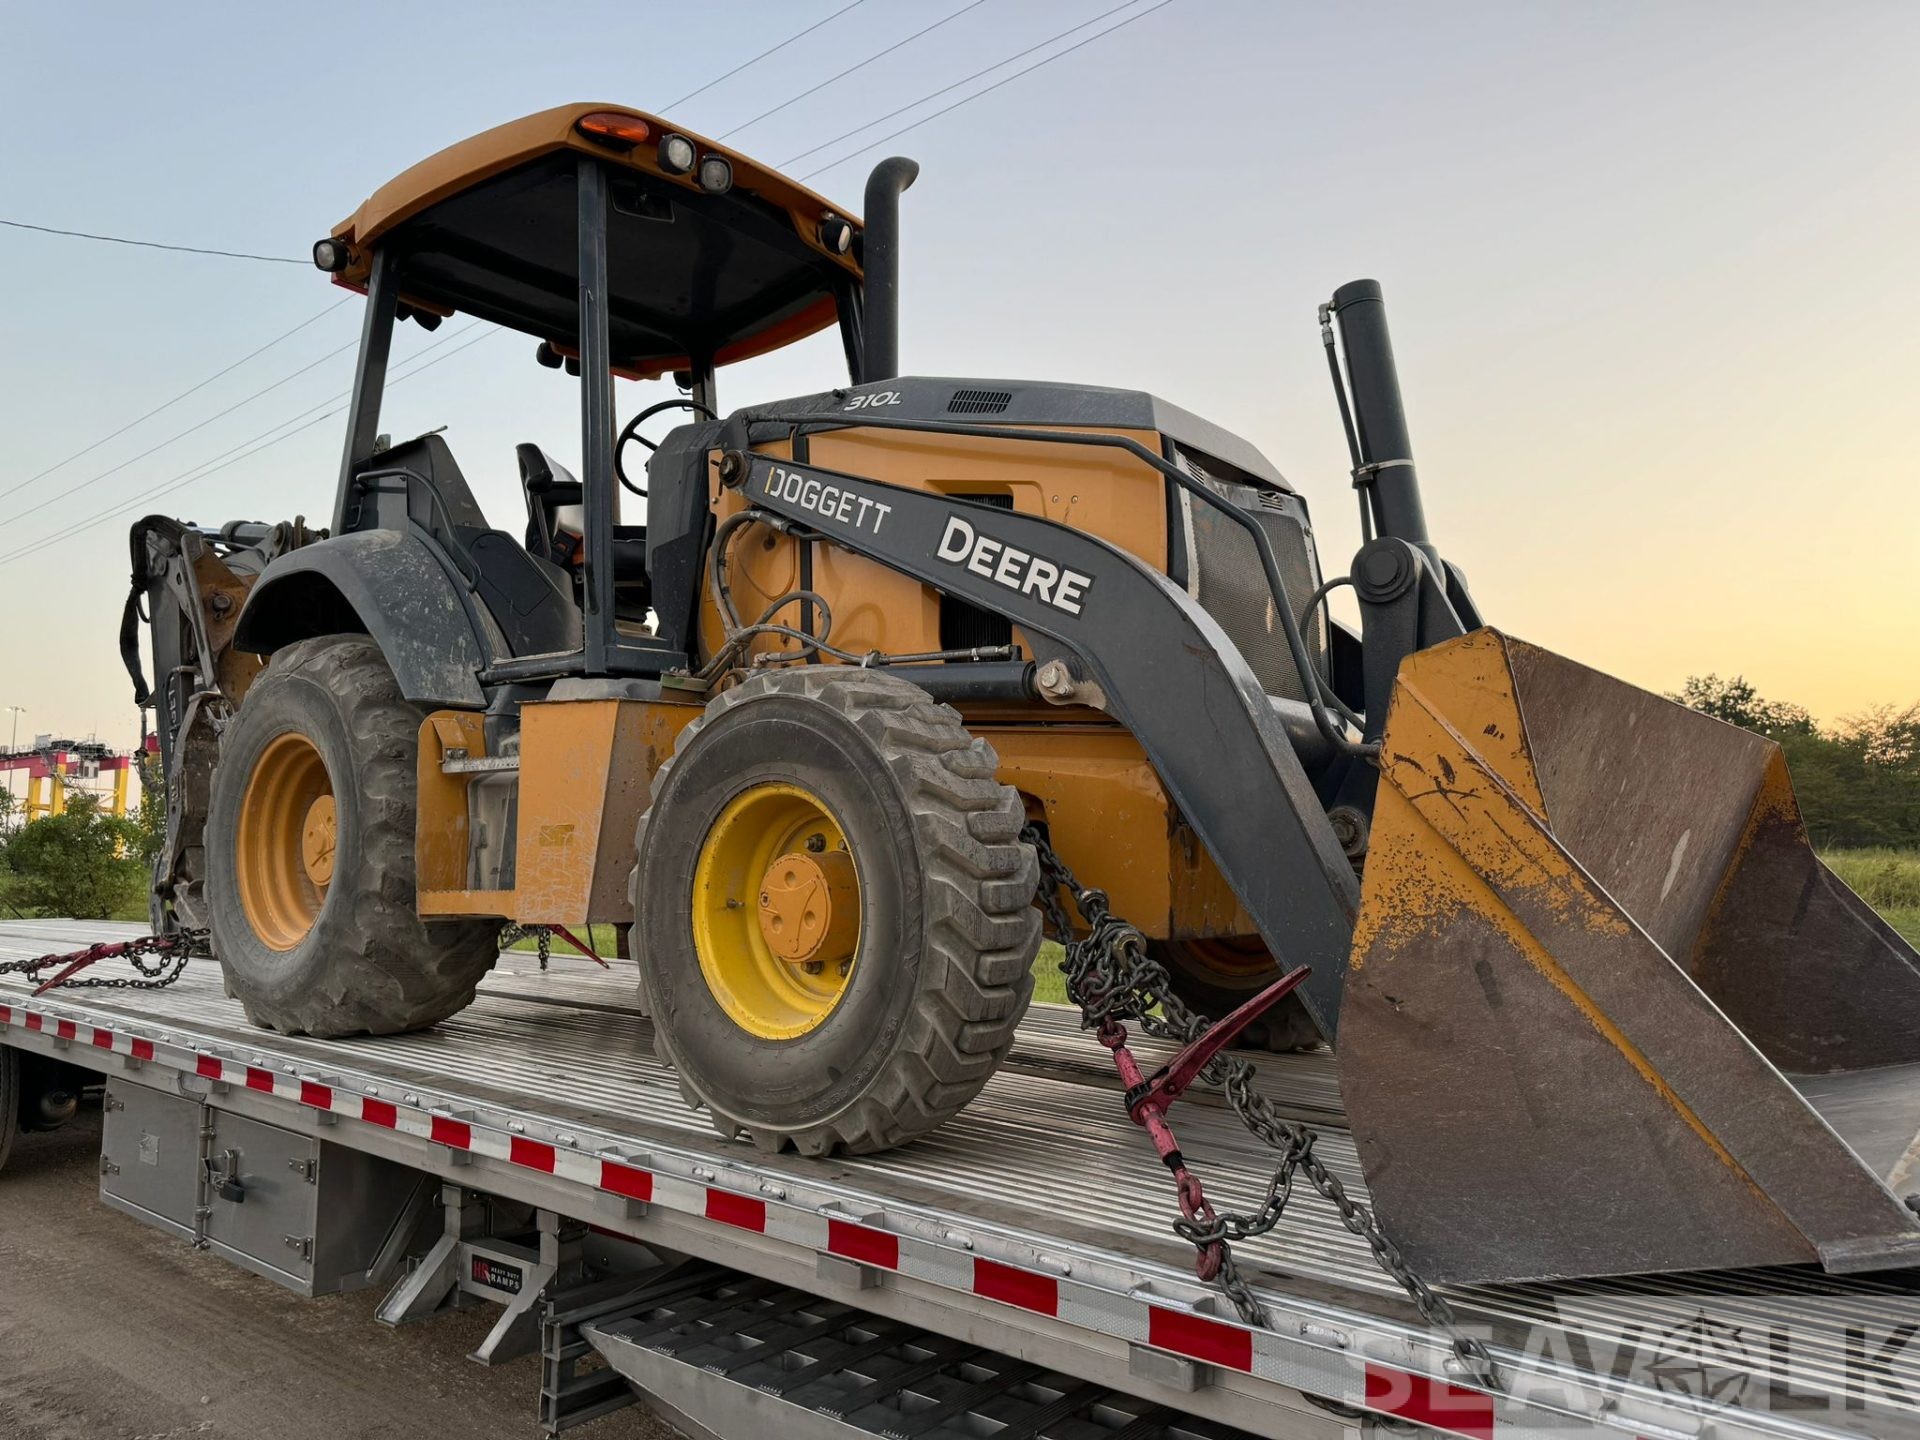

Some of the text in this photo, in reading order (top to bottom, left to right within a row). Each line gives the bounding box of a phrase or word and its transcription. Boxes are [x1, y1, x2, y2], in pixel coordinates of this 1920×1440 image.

[844, 391, 903, 411] 310L
[765, 466, 892, 534] DOGGETT
[937, 515, 1092, 615] DEERE
[491, 1273, 519, 1289] RAMPS
[507, 1271, 519, 1279] DUTY
